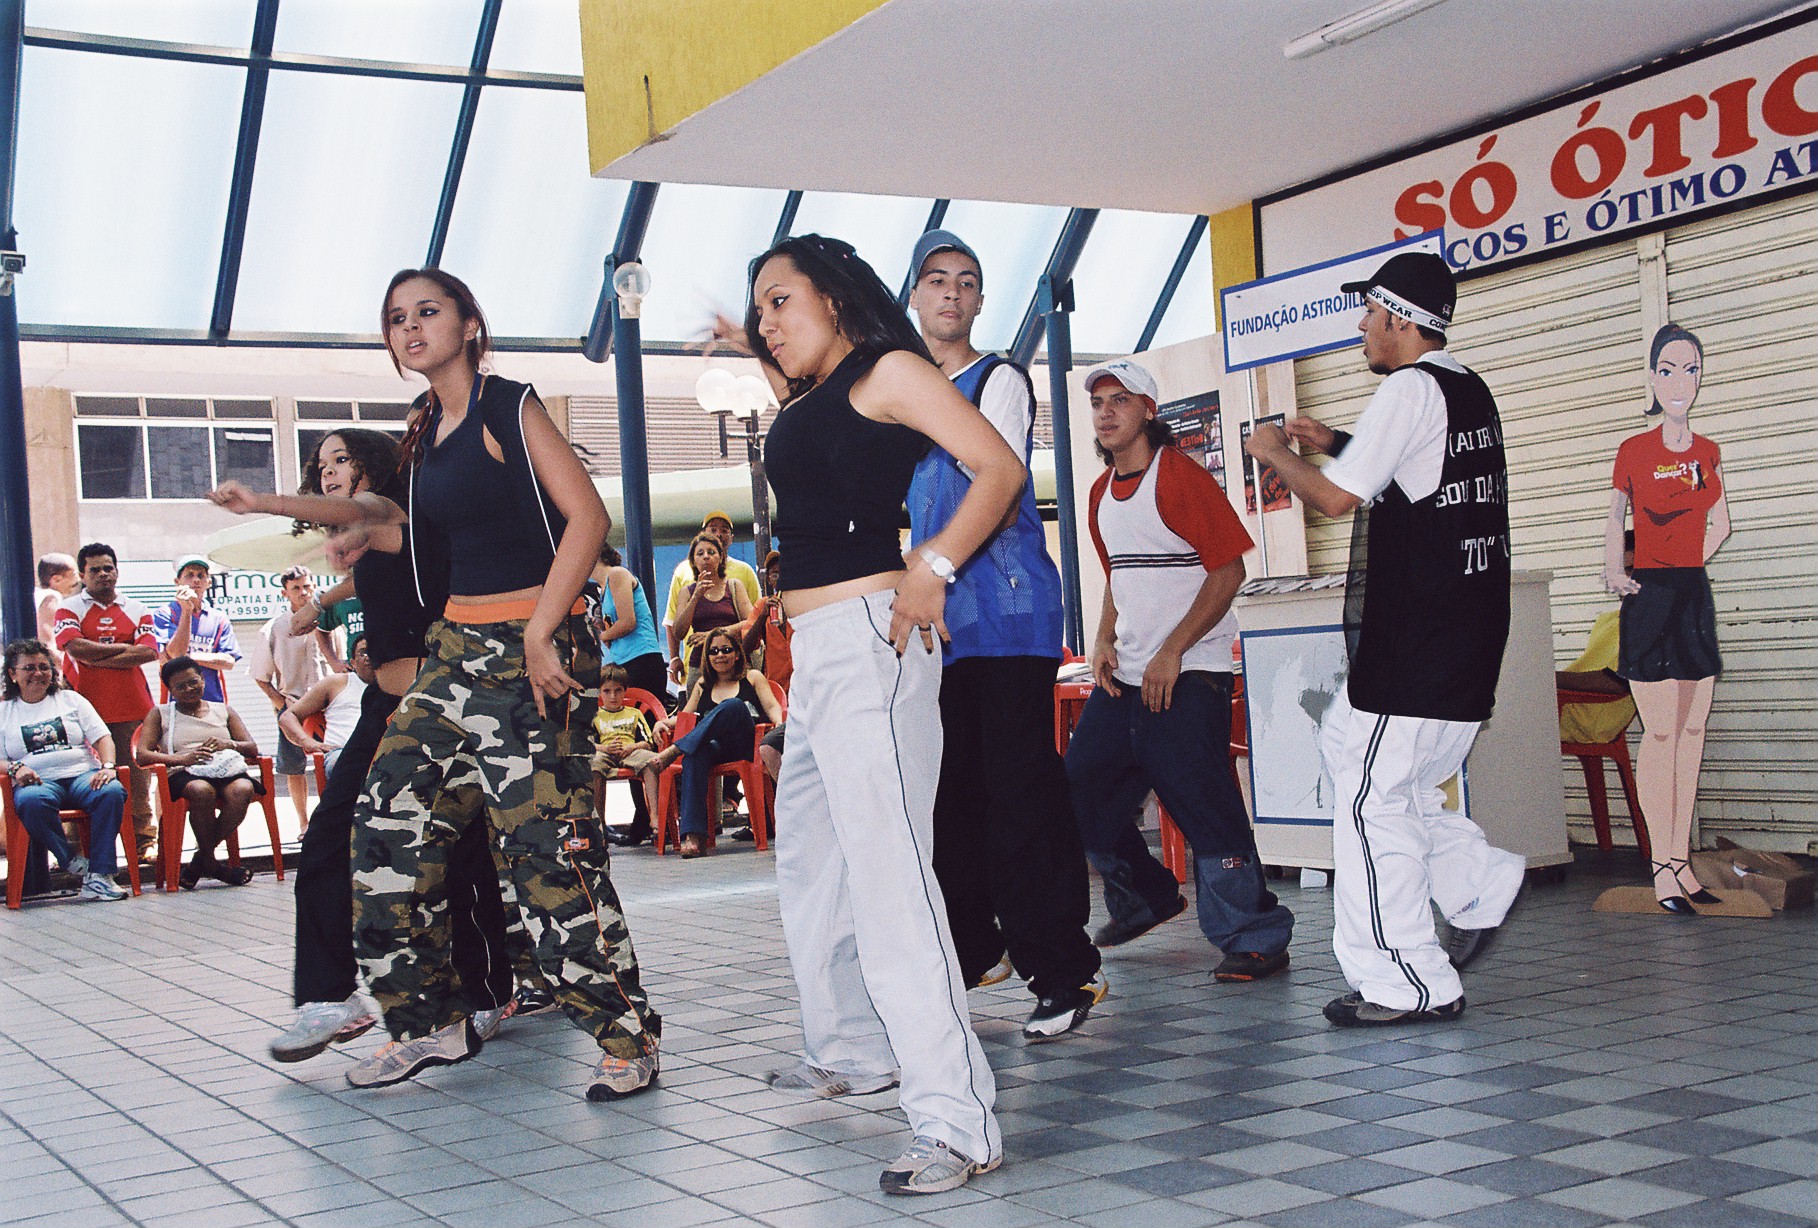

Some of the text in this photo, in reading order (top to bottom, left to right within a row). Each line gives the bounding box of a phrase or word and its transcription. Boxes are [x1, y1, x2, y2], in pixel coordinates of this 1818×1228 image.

[1394, 134, 1518, 243] SÓ
[1544, 211, 1571, 246] E
[1586, 163, 1747, 232] ÓTIMO
[1230, 304, 1298, 338] FUNDAÇÃO
[1383, 294, 1413, 318] WEAR
[217, 594, 261, 604] OPATIA
